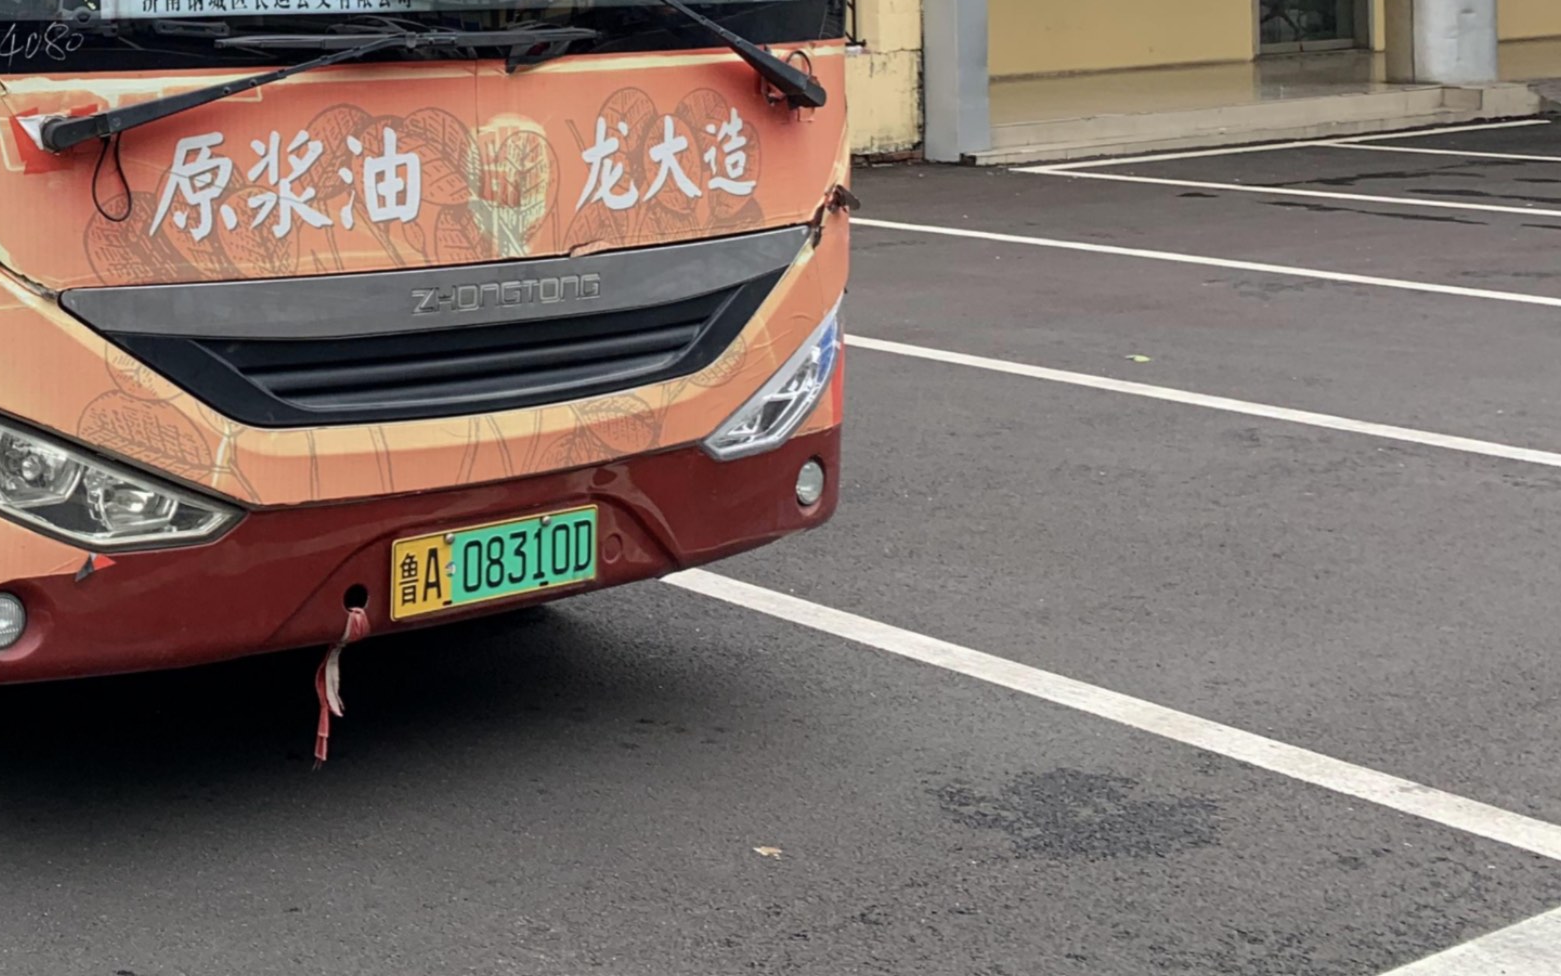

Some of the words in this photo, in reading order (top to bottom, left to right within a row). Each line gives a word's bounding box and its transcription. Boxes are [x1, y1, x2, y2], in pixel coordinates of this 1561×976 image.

[149, 126, 422, 241] 原浆油
[574, 106, 757, 213] 龙大造
[411, 273, 601, 316] ZHONGTONG
[399, 547, 442, 607] 鲁A
[462, 519, 593, 593] 08310D
